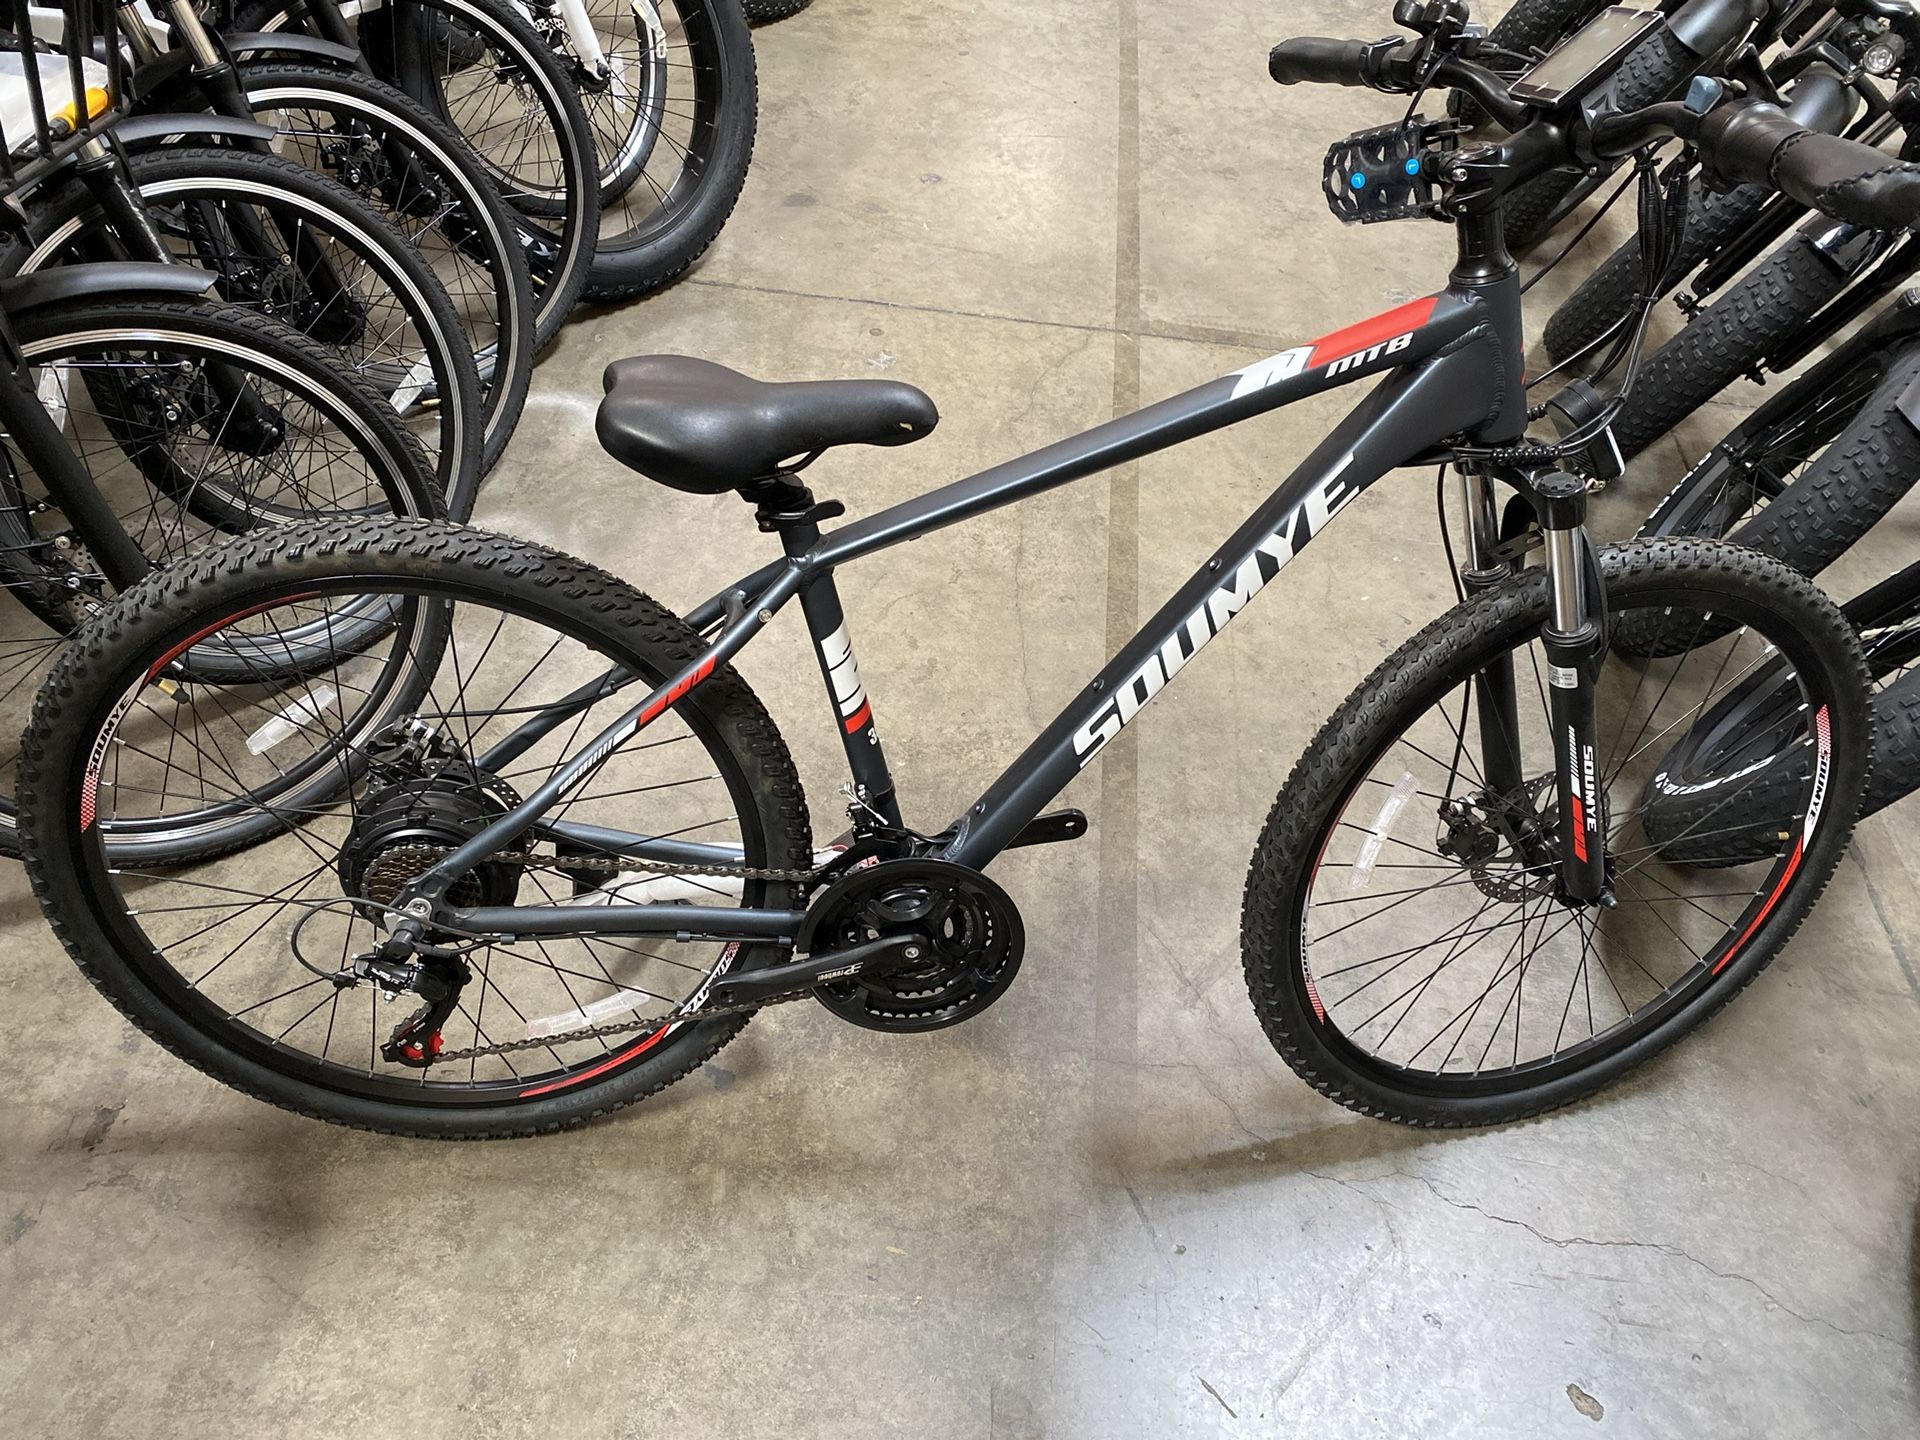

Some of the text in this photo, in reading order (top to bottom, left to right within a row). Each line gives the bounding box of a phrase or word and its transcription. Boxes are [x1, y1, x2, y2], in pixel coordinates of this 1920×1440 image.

[1325, 332, 1414, 379] MTB
[1073, 453, 1360, 769] SOUMYE
[88, 694, 132, 777] SOUMYE
[1583, 745, 1597, 833] SOUMYE
